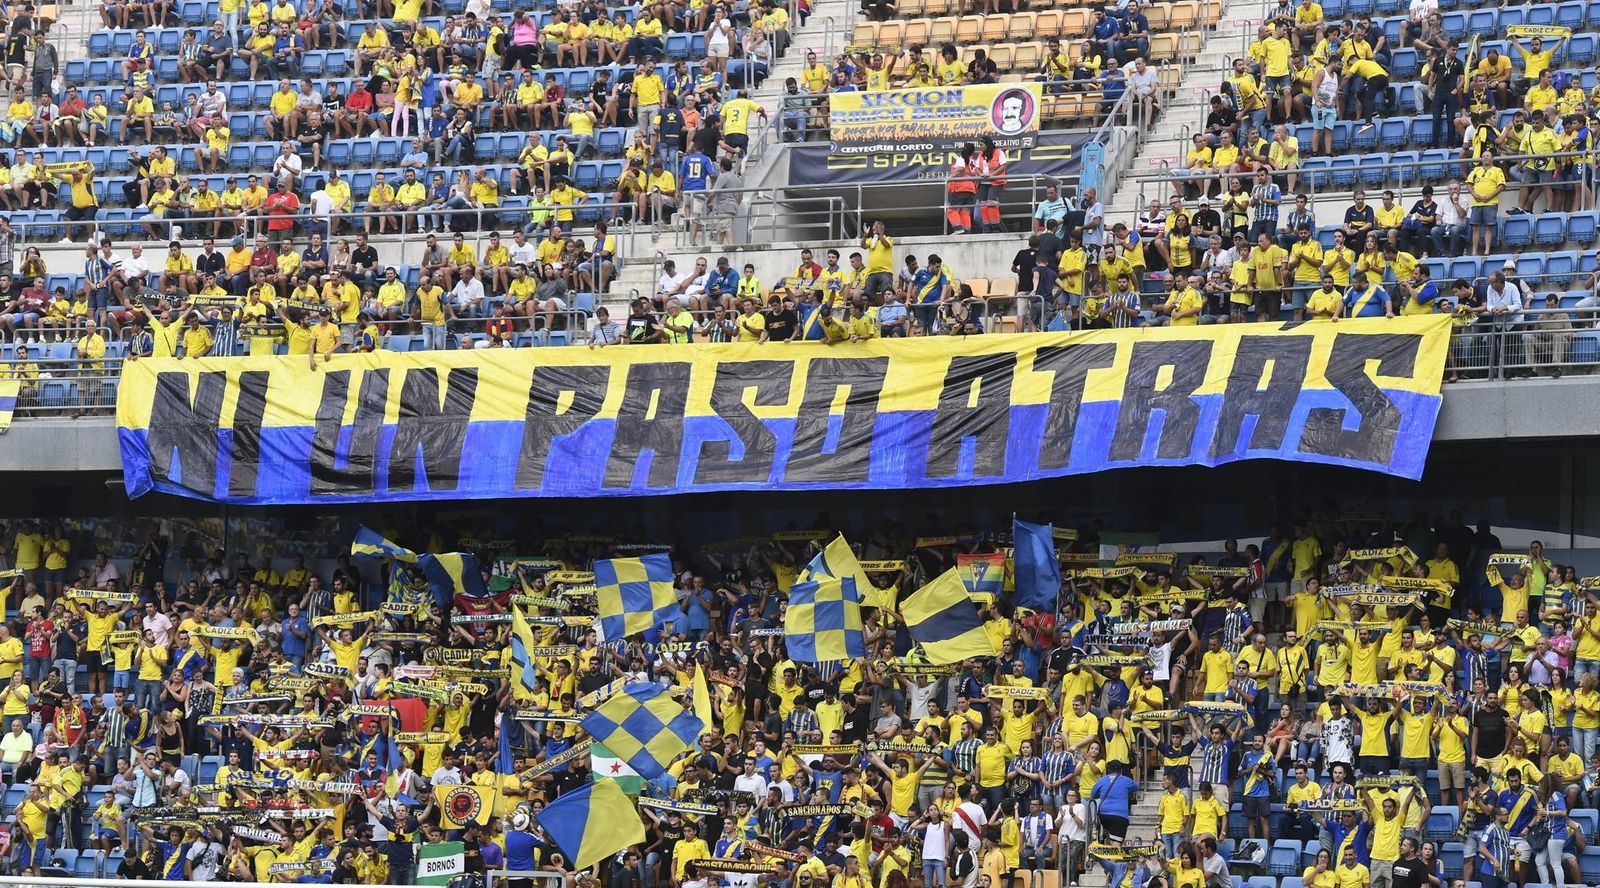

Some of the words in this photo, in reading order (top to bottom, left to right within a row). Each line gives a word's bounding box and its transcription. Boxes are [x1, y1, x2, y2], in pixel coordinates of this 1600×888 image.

[895, 143, 934, 151] LORETO
[873, 149, 1022, 168] SPAGNO
[688, 163, 701, 178] 19
[147, 370, 269, 498] NI
[308, 366, 478, 496] UN
[515, 356, 888, 490] PASO
[926, 321, 1422, 479] ATRÁS
[1355, 548, 1384, 557] CADIZ
[883, 561, 895, 569] de
[1366, 595, 1396, 603] CADIZ
[443, 648, 471, 661] CADIZ
[533, 648, 558, 656] CADIZ
[307, 662, 349, 676] CADIZ
[281, 679, 302, 688] CADIZ
[418, 678, 447, 689] AMOR
[1009, 688, 1034, 696] CADIZ
[349, 704, 381, 713] CADIZ
[398, 732, 416, 741] CADIZ
[788, 804, 841, 816] SANCIONADOS
[426, 857, 456, 873] BORNOS
